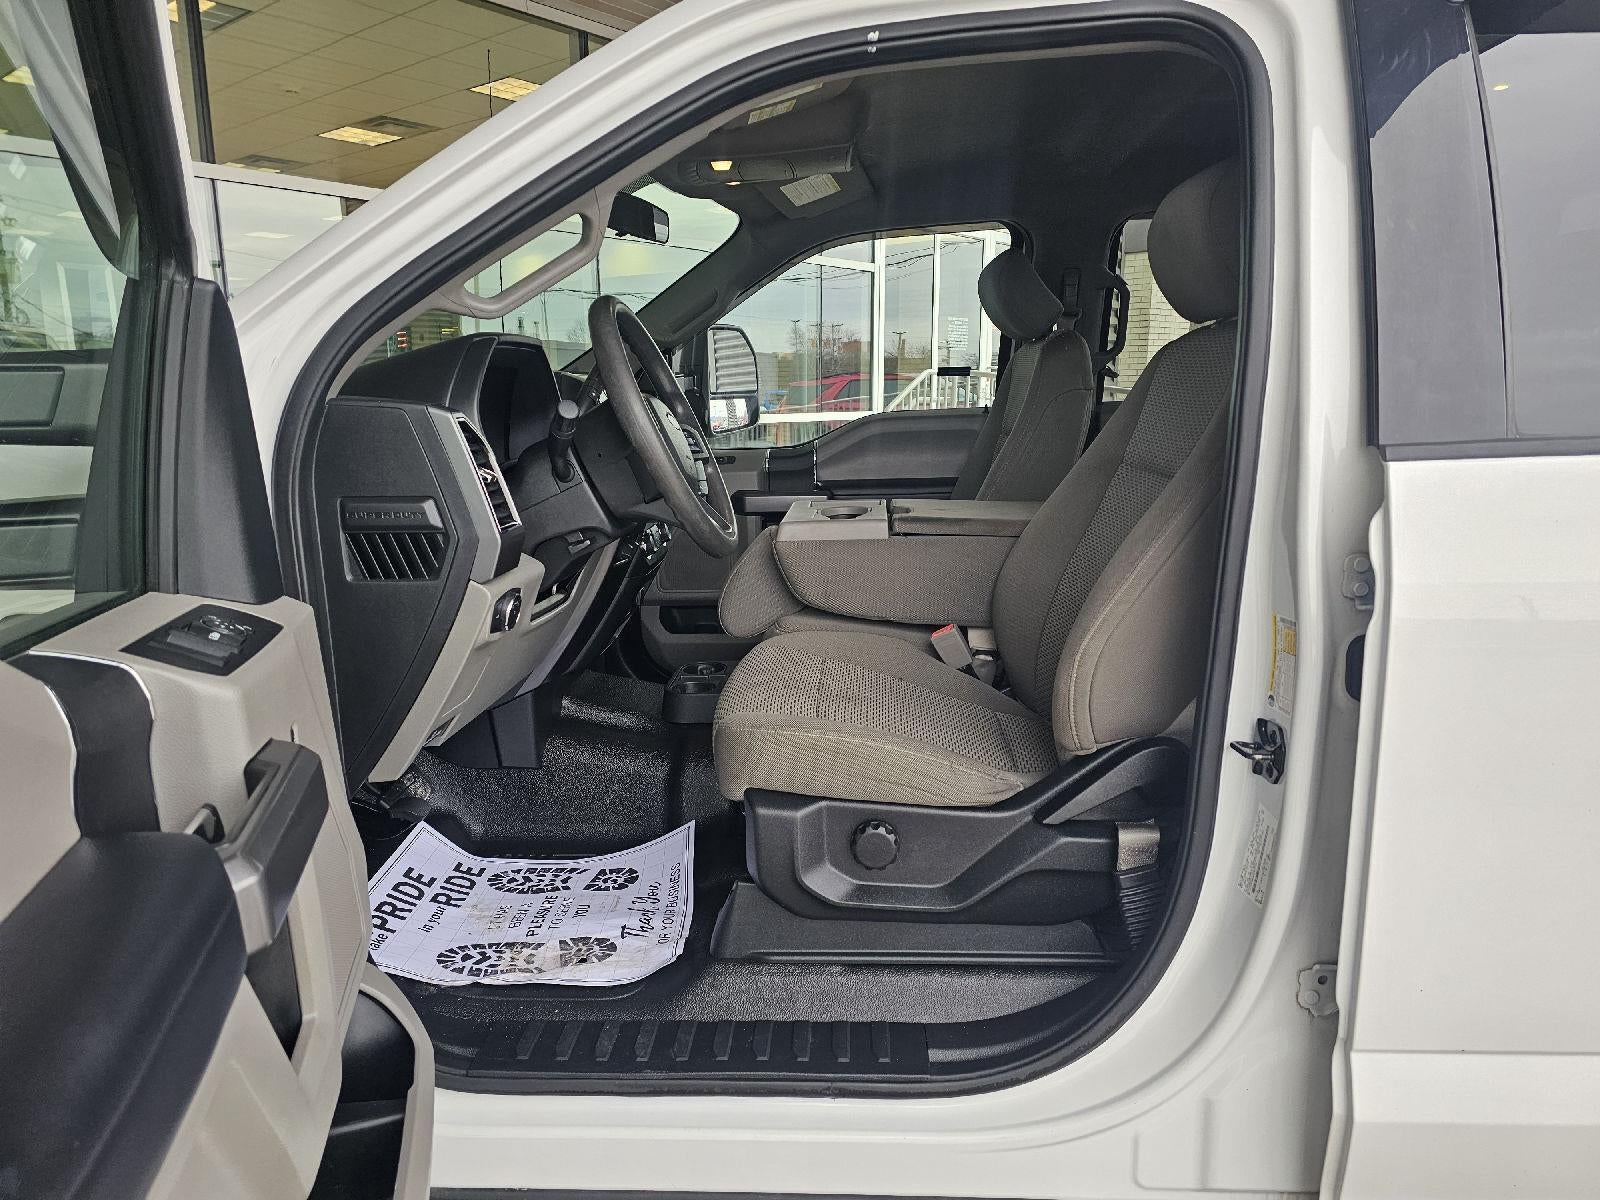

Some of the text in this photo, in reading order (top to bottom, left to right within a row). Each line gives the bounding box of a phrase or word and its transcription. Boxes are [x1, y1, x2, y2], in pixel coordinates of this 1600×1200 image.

[372, 867, 437, 934] PRIDE
[418, 861, 487, 932] in your RIDE
[666, 862, 681, 908] BUSINESS
[508, 909, 529, 929] BEEN
[526, 895, 558, 937] PLEASURE
[572, 904, 590, 918] YOU
